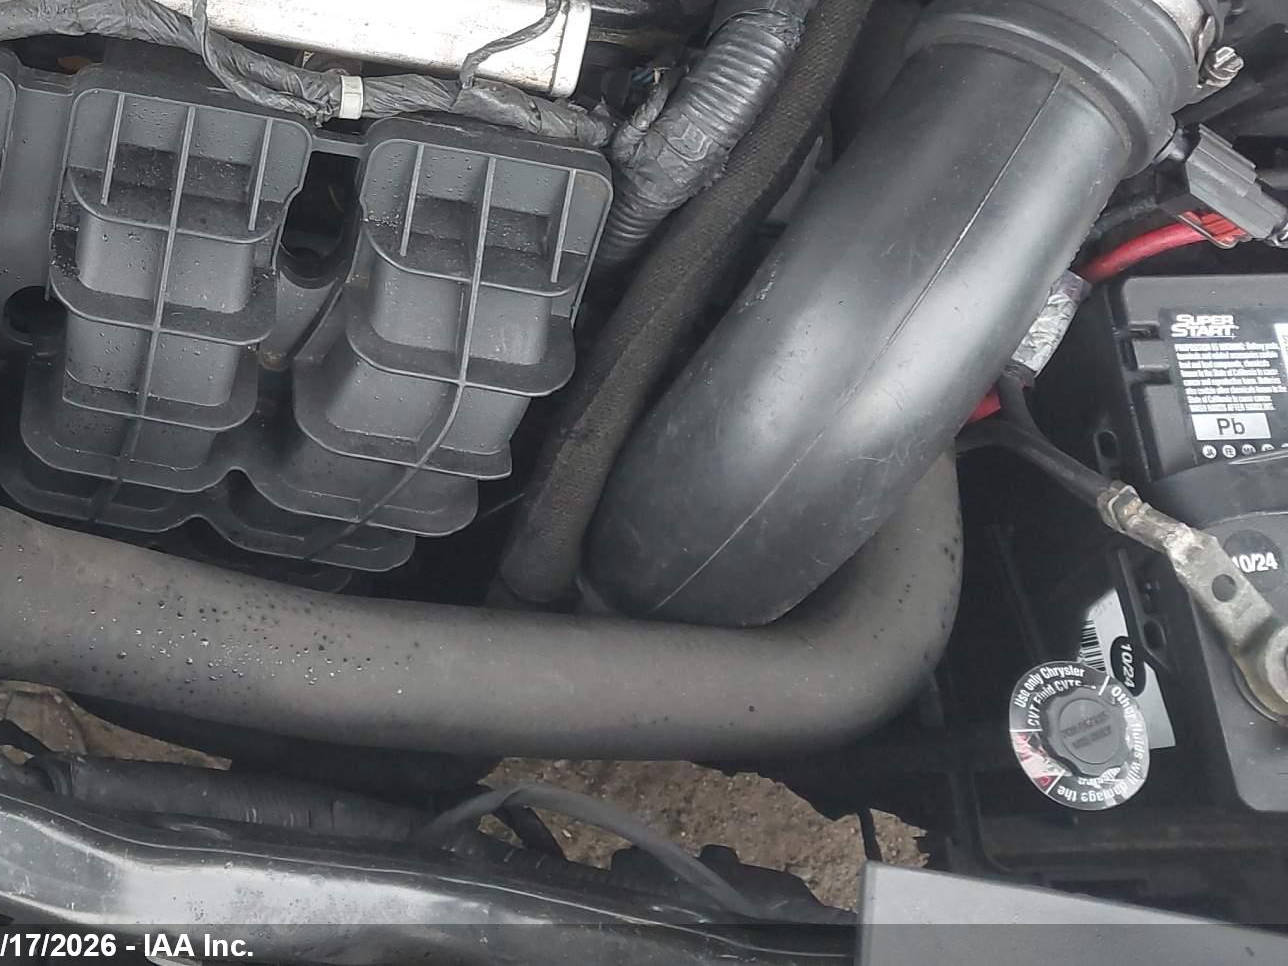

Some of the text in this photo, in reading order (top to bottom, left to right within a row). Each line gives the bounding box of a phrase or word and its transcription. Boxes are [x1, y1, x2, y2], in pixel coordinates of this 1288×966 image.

[1176, 314, 1233, 325] SUPER
[1171, 323, 1238, 338] START
[1216, 418, 1245, 435] Pb
[1120, 643, 1135, 688] 10/24
[1014, 665, 1085, 708] Use only Chrysler
[1033, 684, 1056, 704] Fluid
[1027, 704, 1040, 726] CVT
[1057, 785, 1077, 802] the
